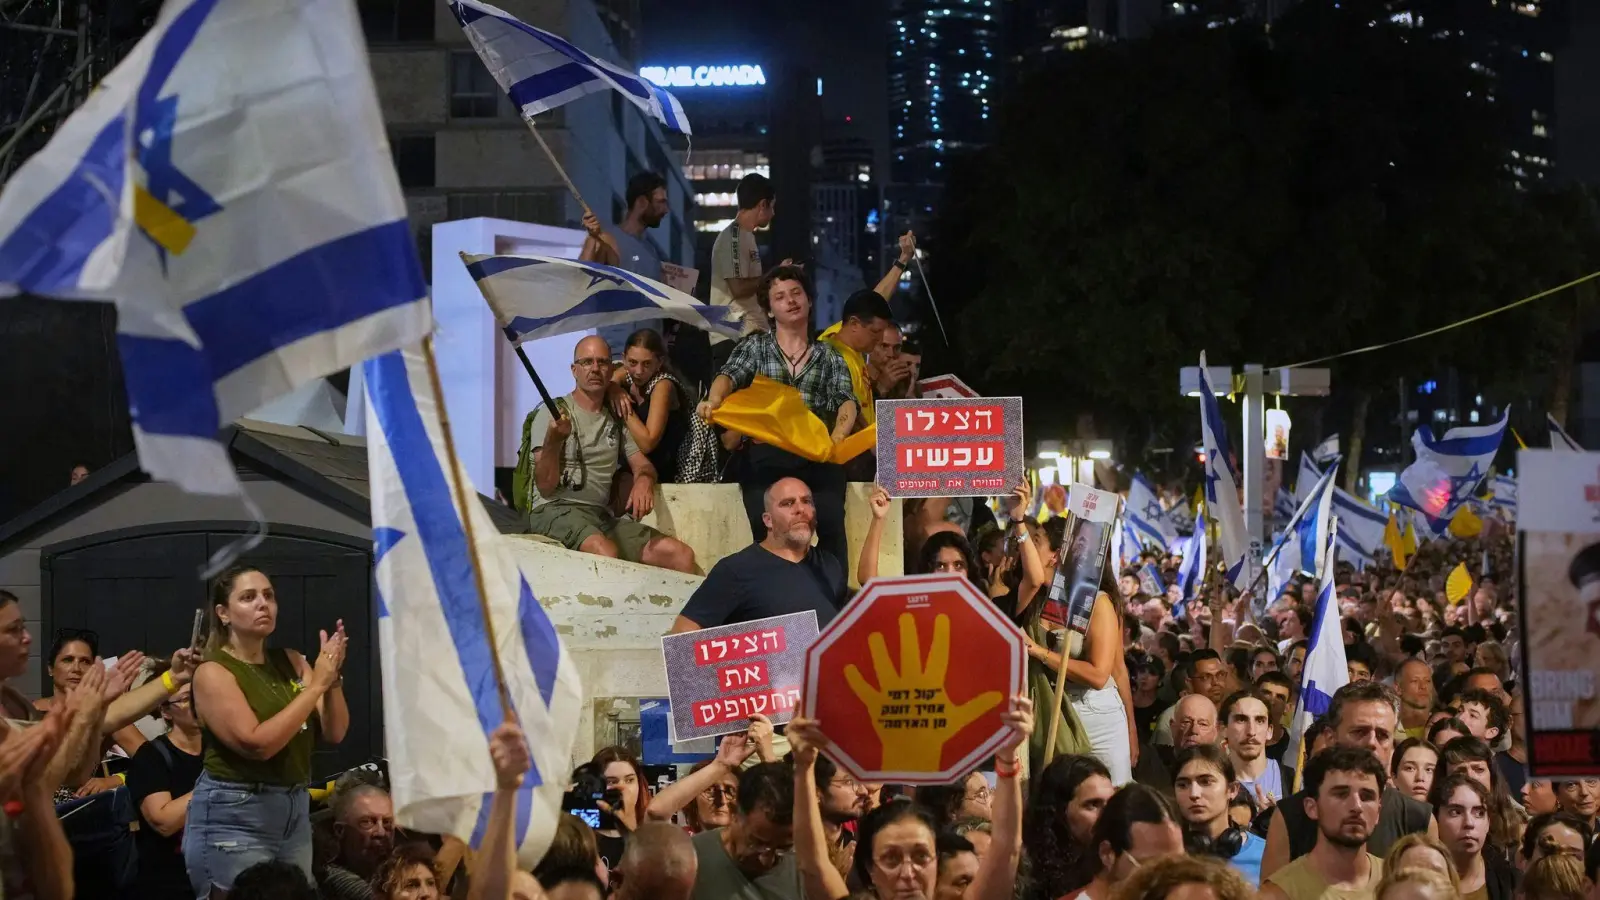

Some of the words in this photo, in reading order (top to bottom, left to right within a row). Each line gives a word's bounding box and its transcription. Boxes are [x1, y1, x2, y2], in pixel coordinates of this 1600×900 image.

[695, 65, 766, 86] CANADA
[905, 409, 993, 432] הצילו
[906, 447, 994, 468] עכשיו
[899, 480, 937, 489] החטופים
[947, 479, 962, 488] את
[700, 631, 778, 661] הצילו
[725, 665, 762, 687] את
[1529, 671, 1596, 700] BRING
[888, 689, 910, 701] דמי
[699, 689, 801, 724] החטופים
[916, 703, 945, 715] אחיך
[1532, 701, 1574, 731] HIM
[933, 718, 947, 729] מן
